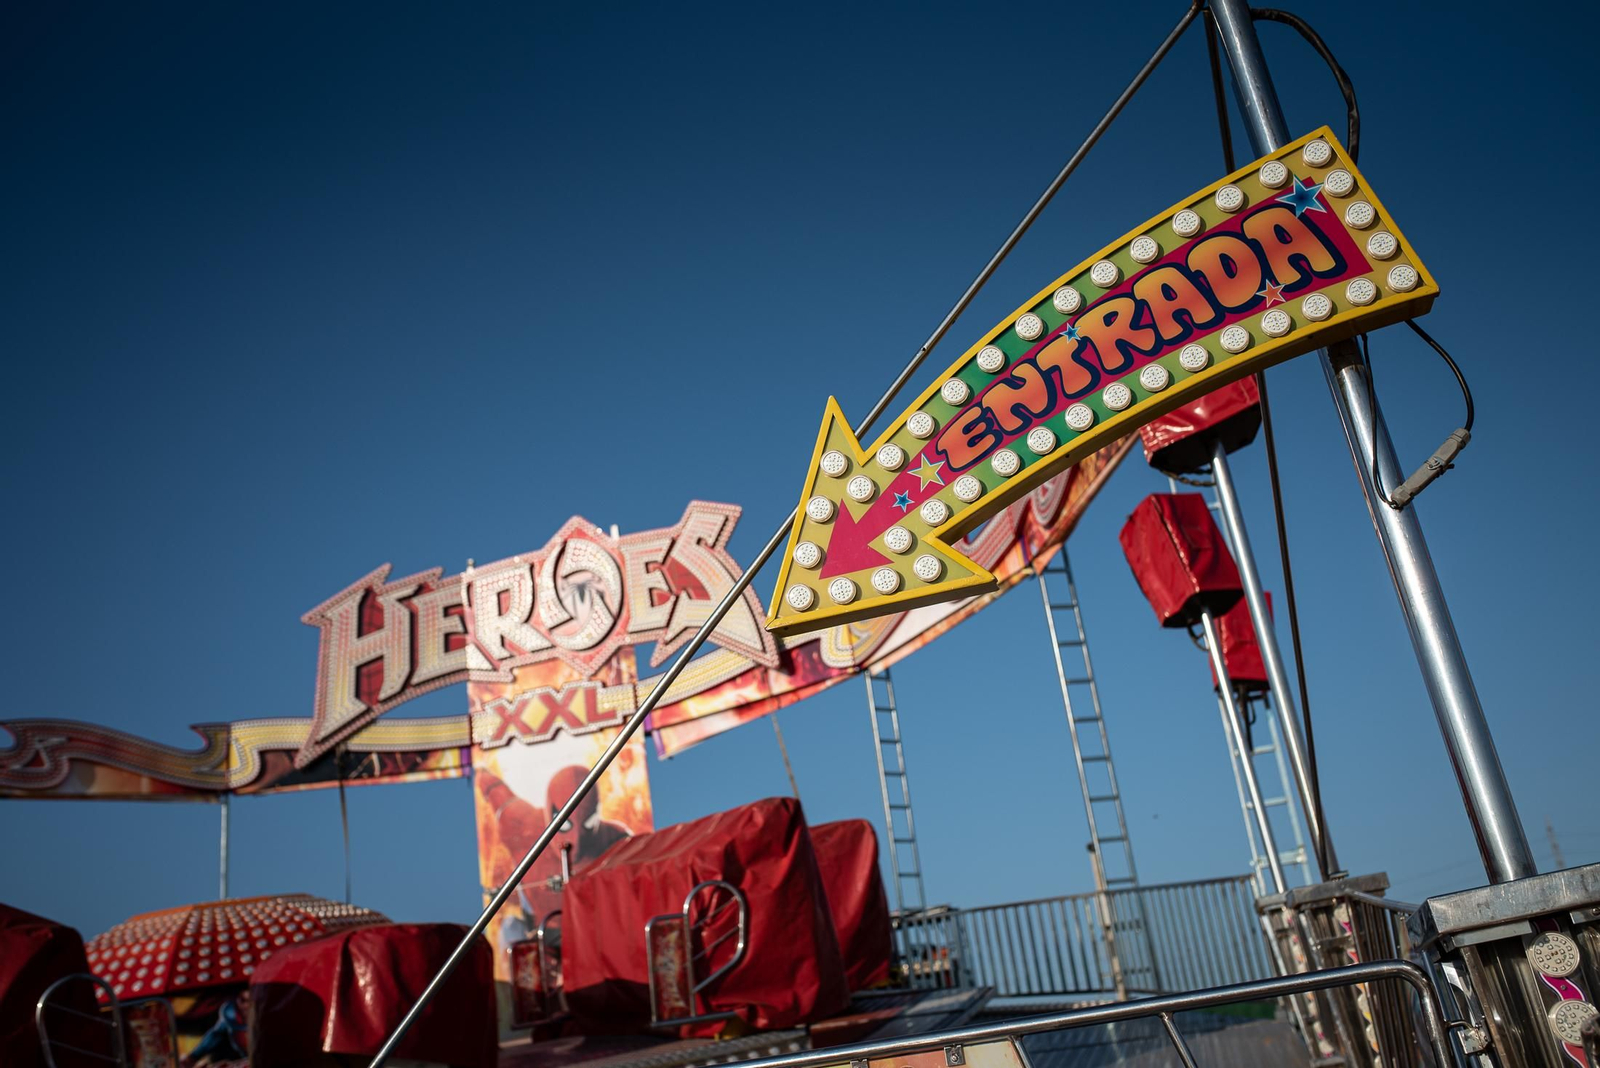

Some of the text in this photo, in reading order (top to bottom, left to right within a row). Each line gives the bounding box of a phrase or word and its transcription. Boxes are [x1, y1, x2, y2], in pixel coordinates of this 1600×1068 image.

[937, 204, 1345, 471] ENTRADA
[306, 504, 776, 760] HEROES
[491, 689, 619, 742] XXL
